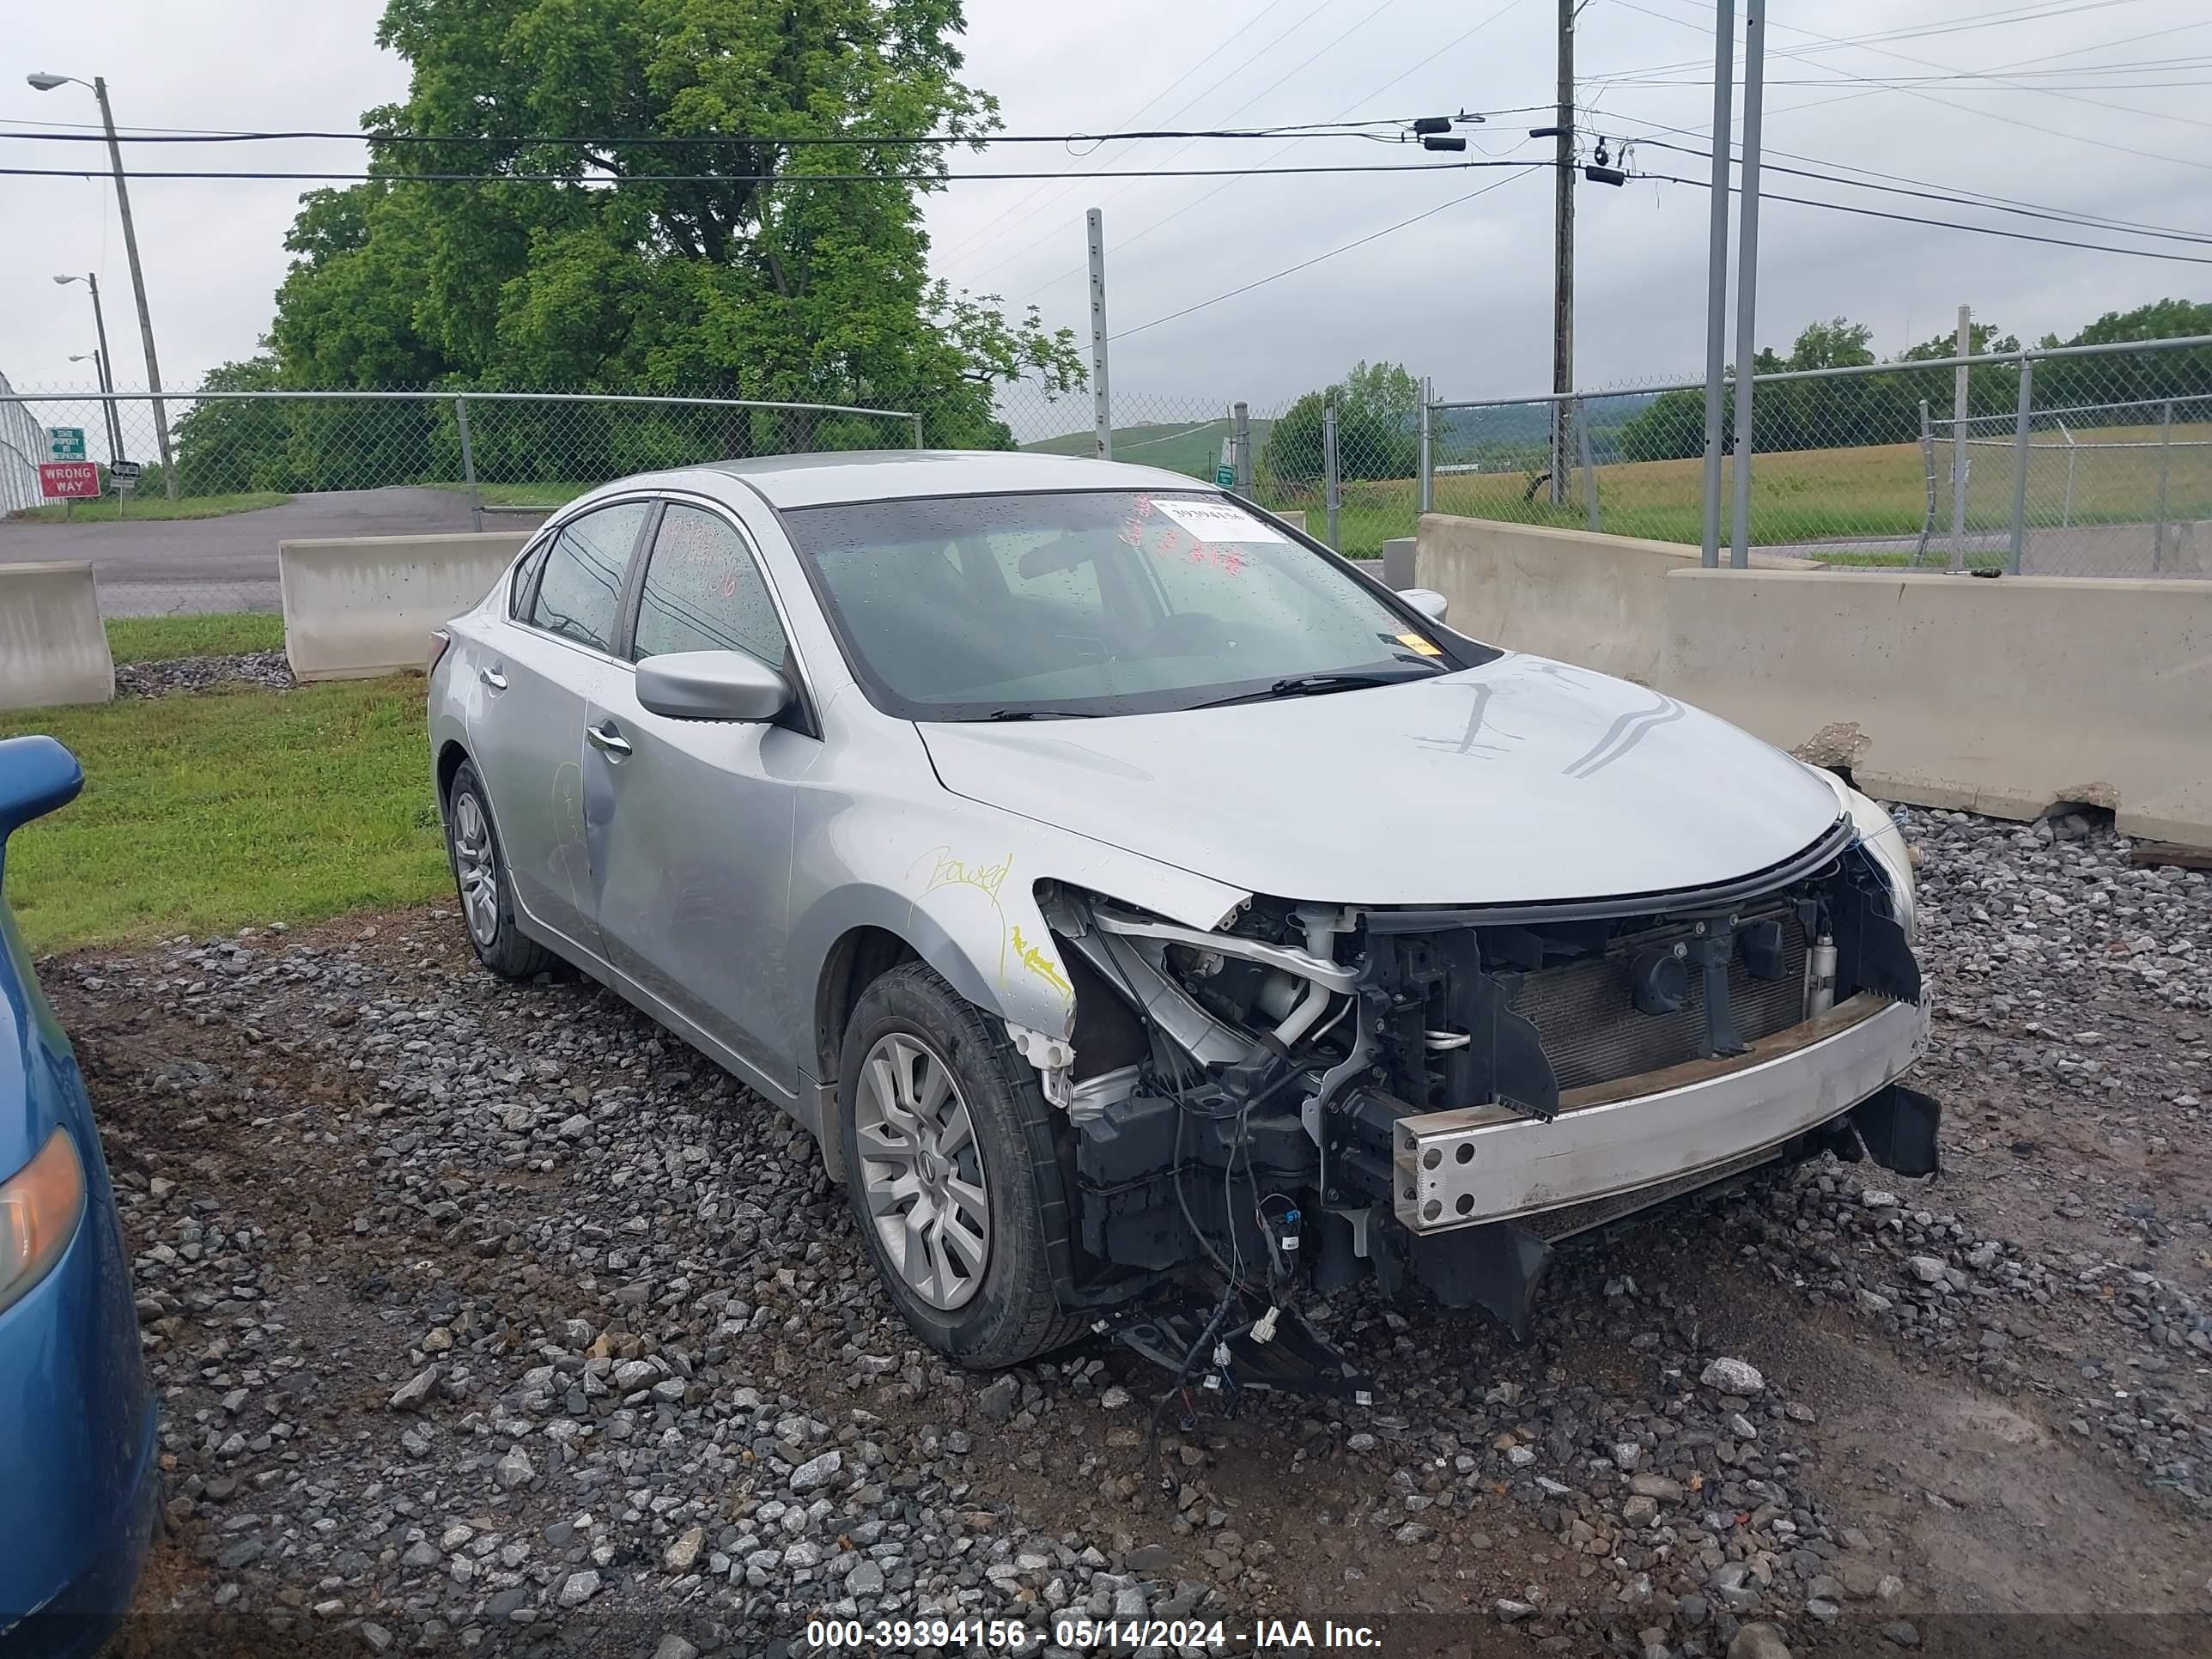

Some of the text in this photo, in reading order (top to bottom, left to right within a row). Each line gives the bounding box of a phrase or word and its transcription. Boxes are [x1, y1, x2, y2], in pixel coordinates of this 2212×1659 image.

[46, 468, 91, 479] WRONG
[57, 481, 83, 492] WAY
[1172, 508, 1246, 521] 39394156
